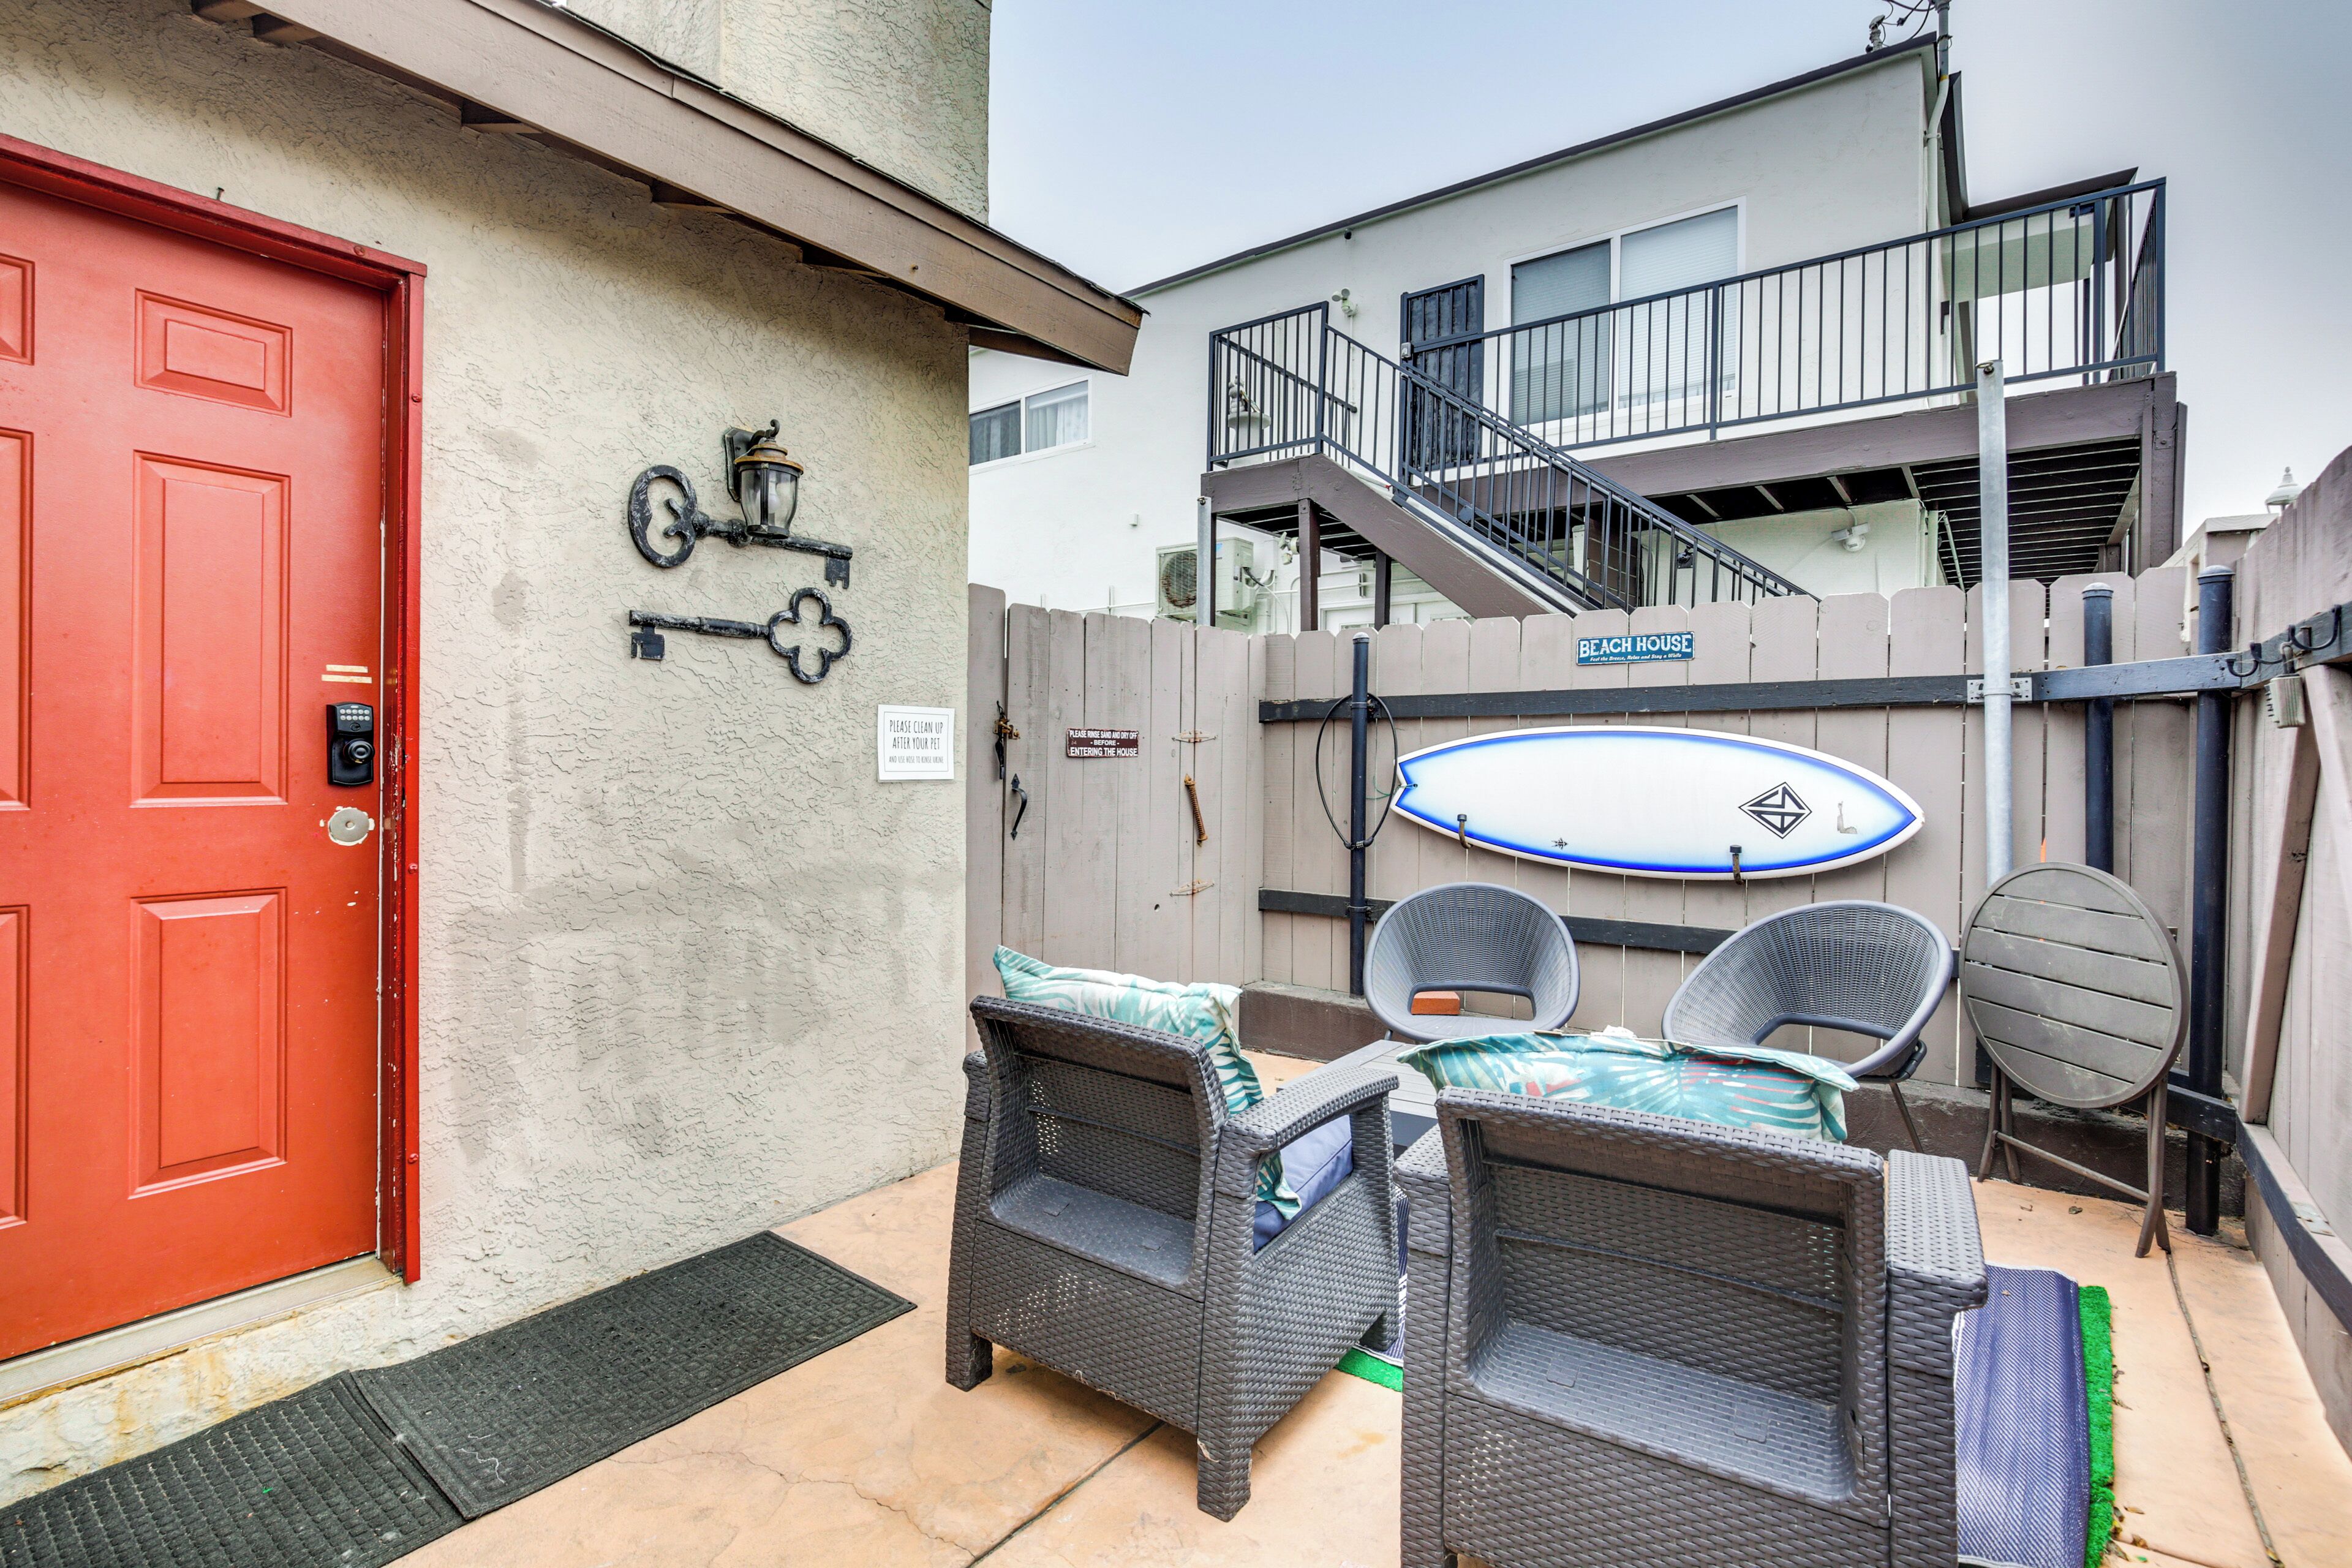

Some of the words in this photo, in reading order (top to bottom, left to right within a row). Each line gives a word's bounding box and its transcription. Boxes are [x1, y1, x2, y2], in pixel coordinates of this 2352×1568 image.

[1579, 637, 1632, 658] BEACH
[1636, 635, 1692, 652] HOUSE
[889, 720, 911, 733] PLEASE
[913, 721, 933, 734] CLEAN
[935, 722, 943, 734] UP
[892, 737, 911, 749] AFTER
[913, 737, 929, 750] YOUR
[930, 737, 940, 750] PET
[1071, 747, 1102, 756] ENTERING
